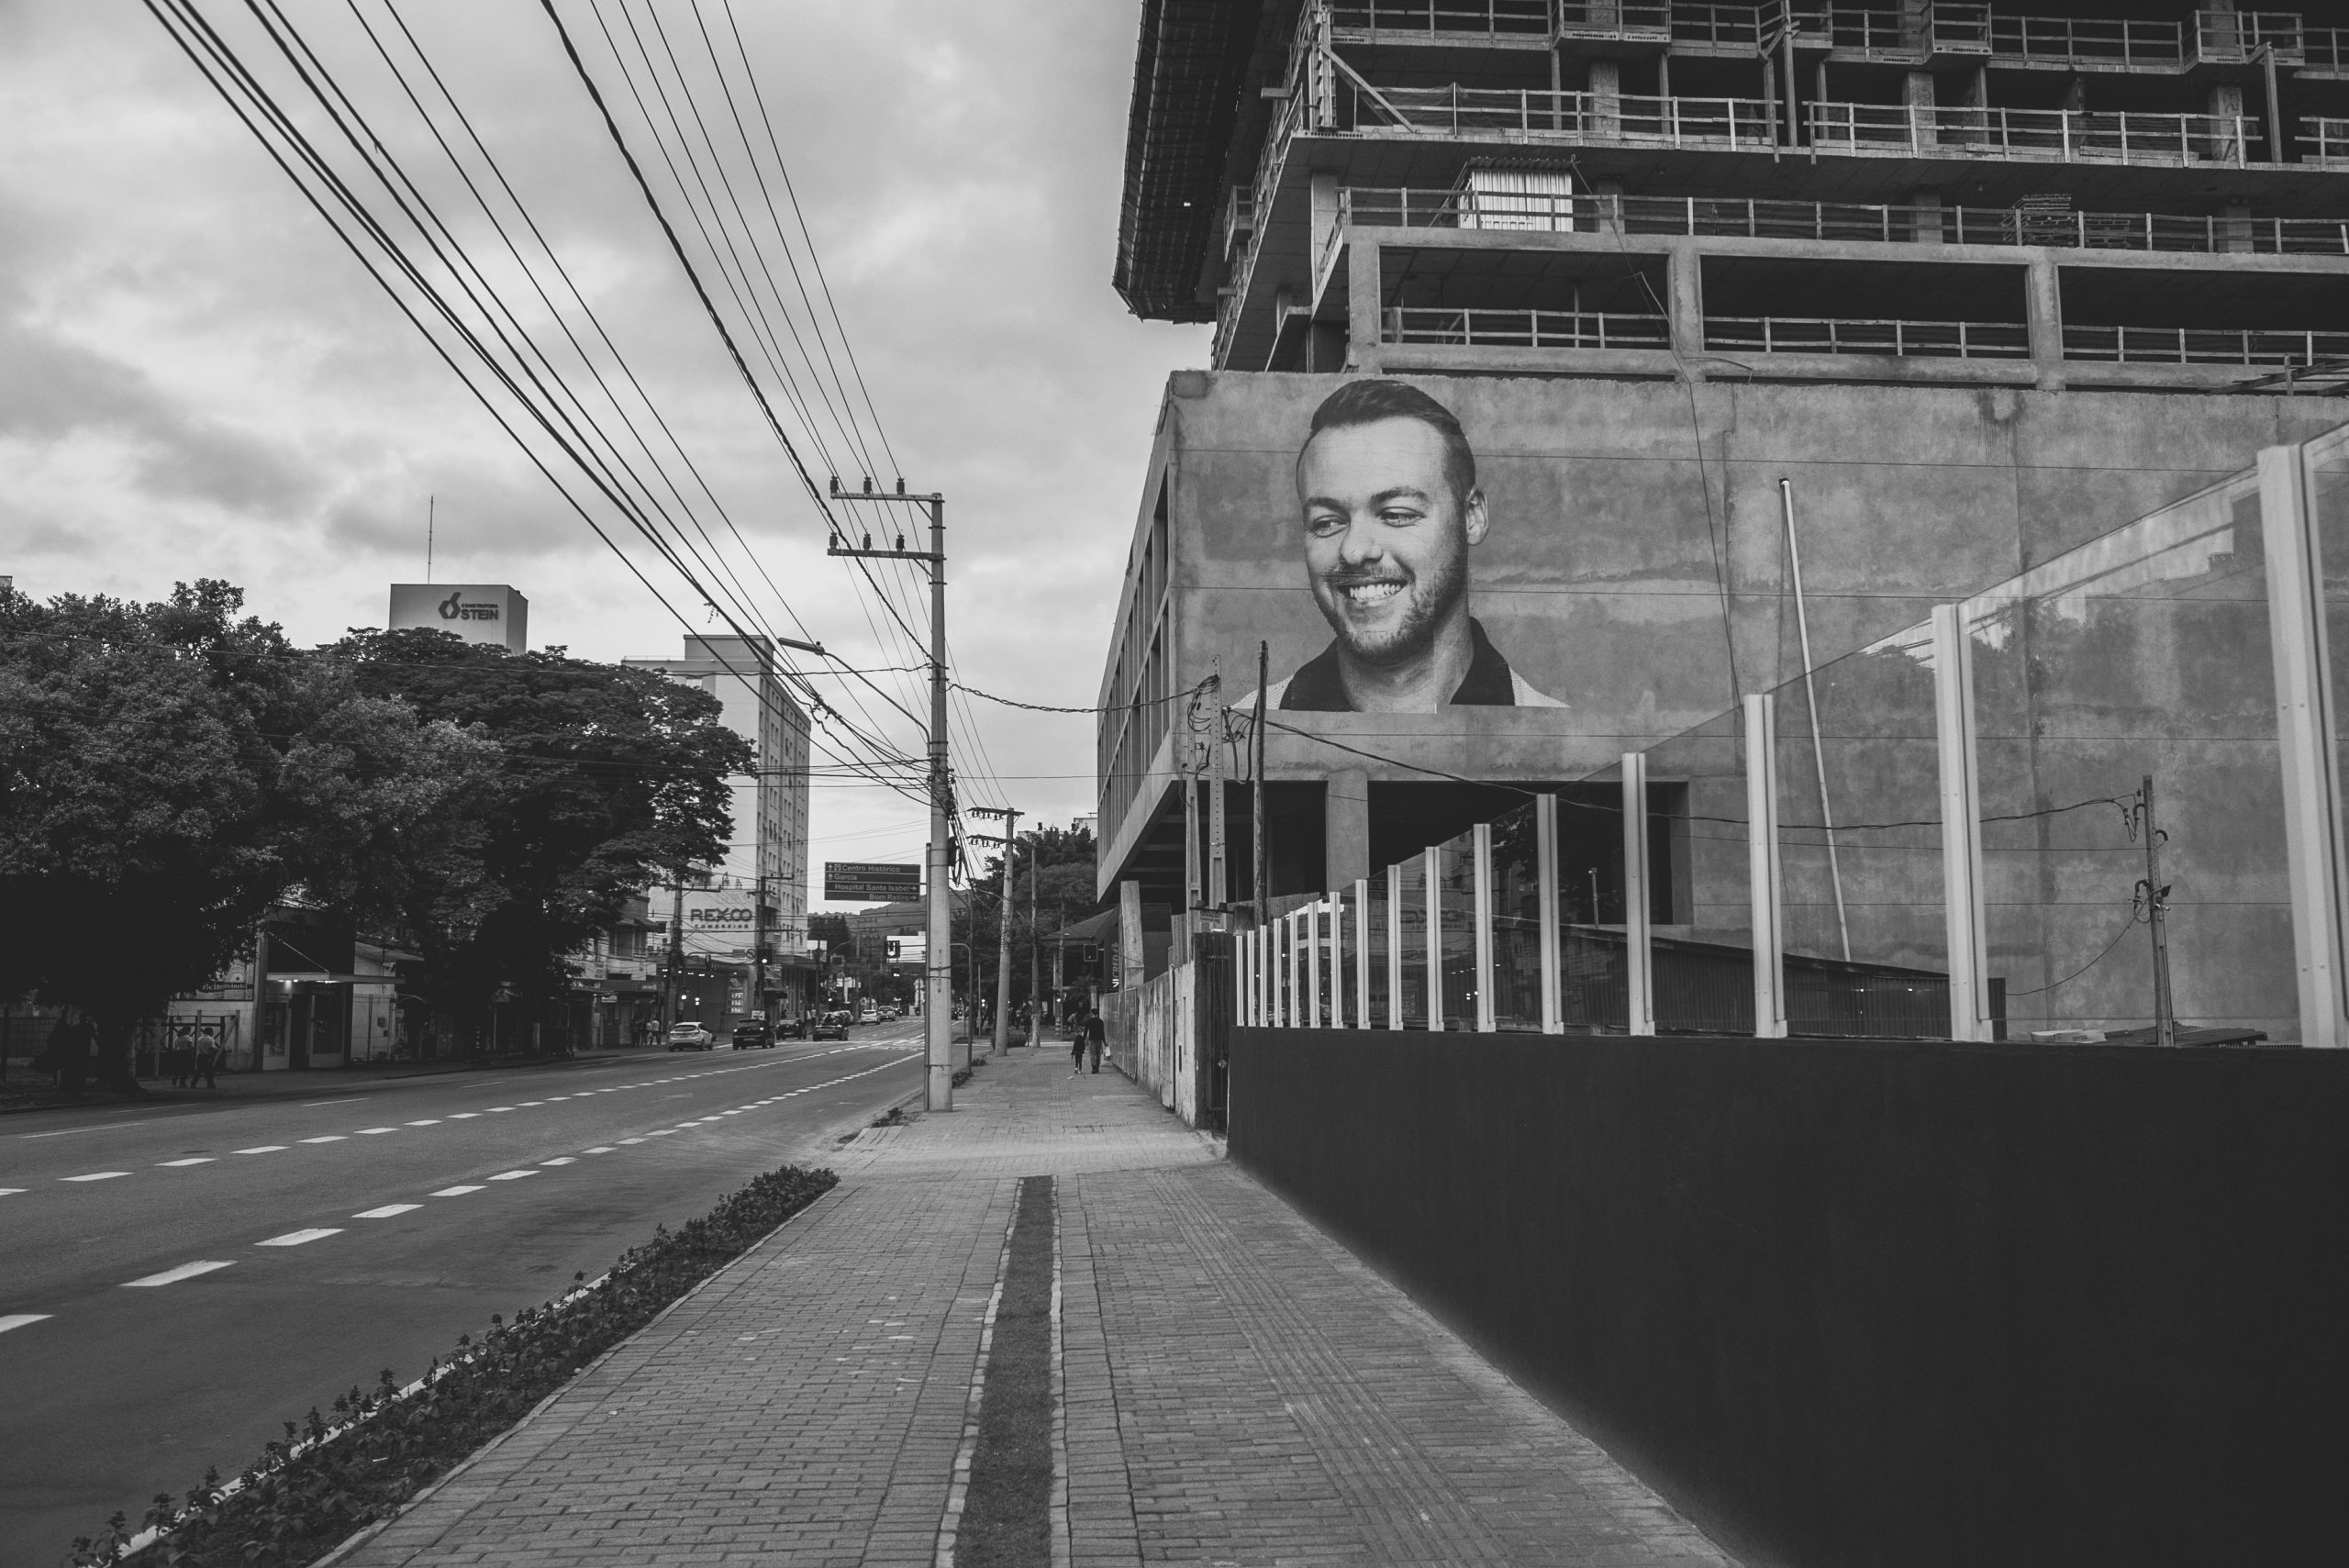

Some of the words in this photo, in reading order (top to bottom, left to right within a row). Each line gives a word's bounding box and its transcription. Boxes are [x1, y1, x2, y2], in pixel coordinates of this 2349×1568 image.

[461, 608, 499, 620] STEIN
[834, 884, 863, 892] Hospital
[691, 907, 752, 922] REXCO
